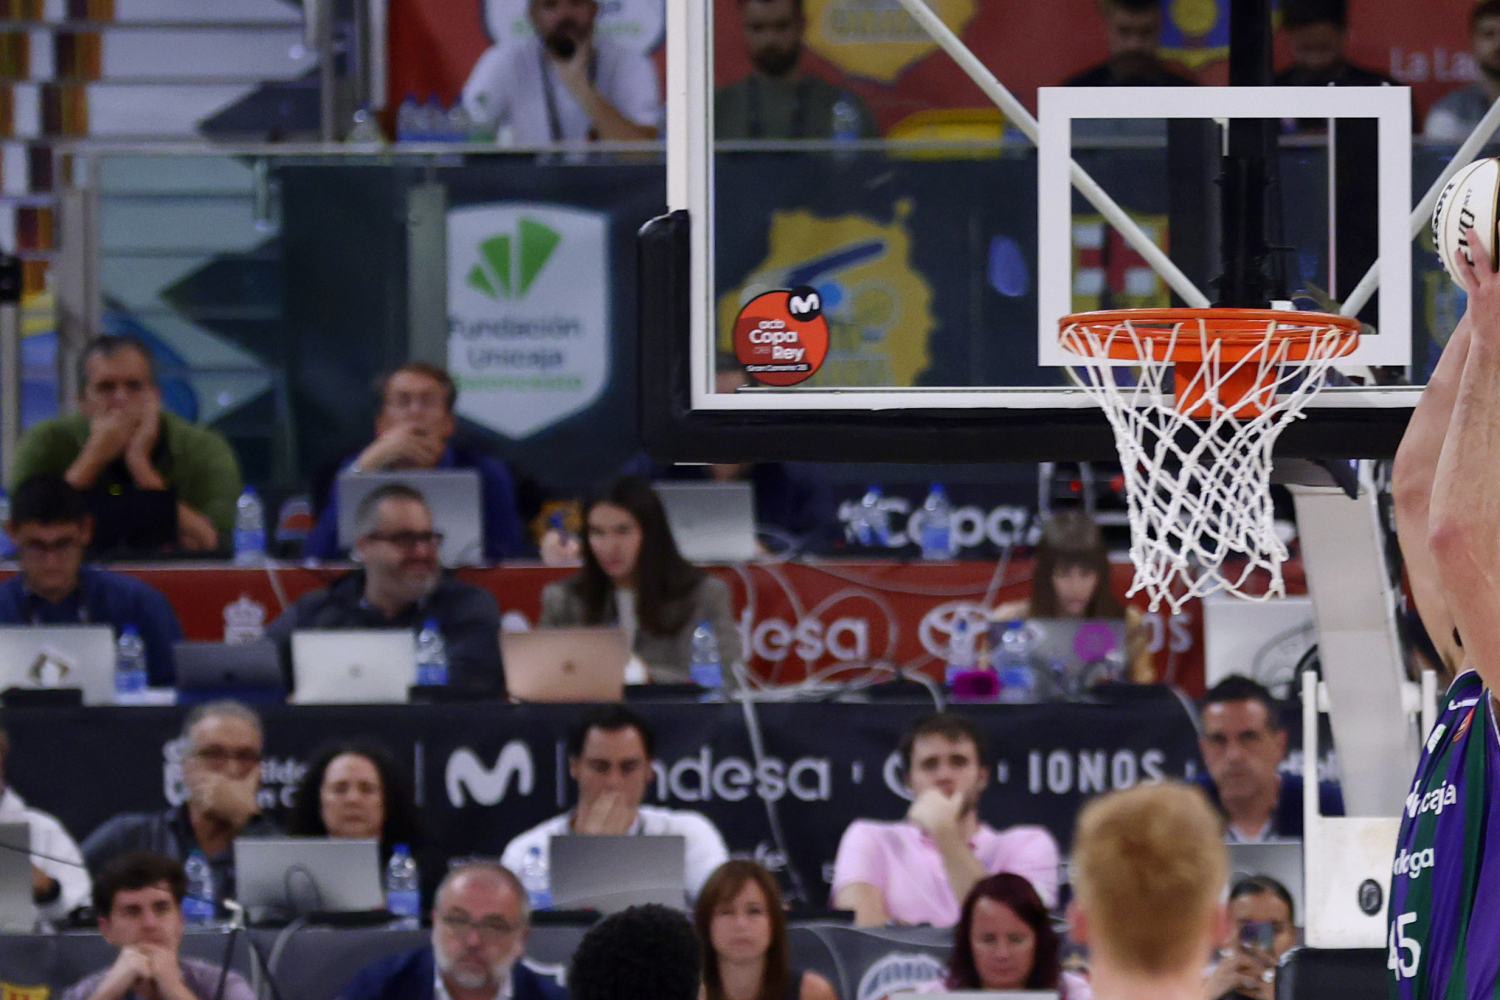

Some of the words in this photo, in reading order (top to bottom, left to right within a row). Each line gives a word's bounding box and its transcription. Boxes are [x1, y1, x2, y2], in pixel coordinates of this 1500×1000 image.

[758, 319, 786, 330] acb
[748, 329, 799, 346] Copa
[771, 345, 807, 362] Rey
[1028, 748, 1167, 795] IONOS
[1387, 911, 1422, 981] 45
